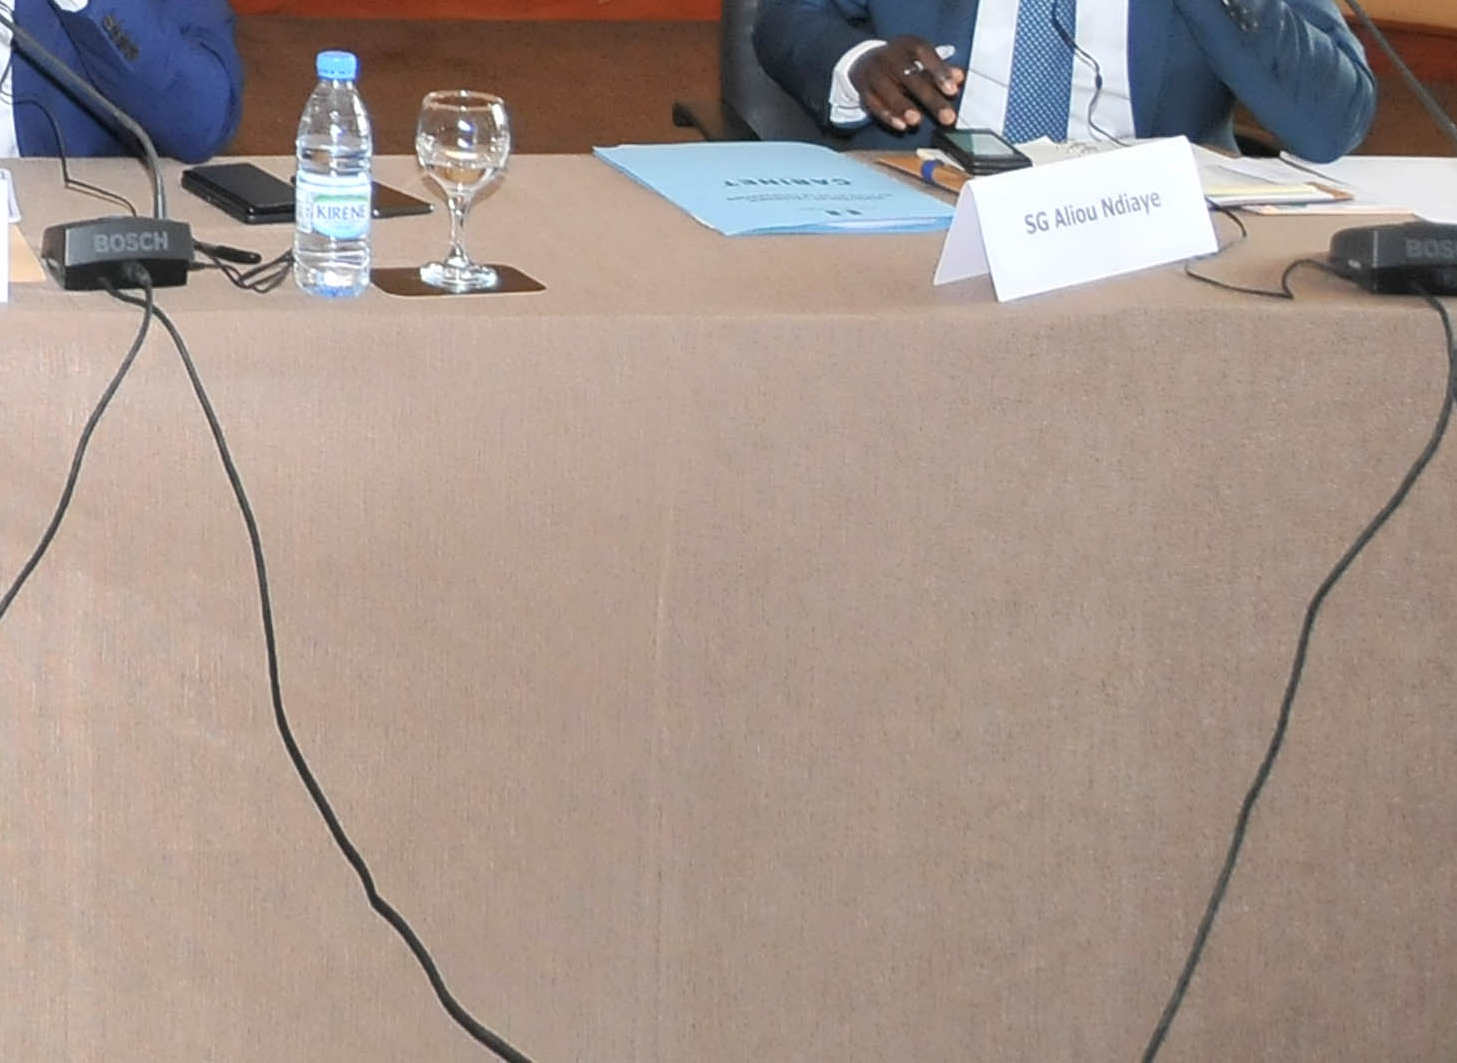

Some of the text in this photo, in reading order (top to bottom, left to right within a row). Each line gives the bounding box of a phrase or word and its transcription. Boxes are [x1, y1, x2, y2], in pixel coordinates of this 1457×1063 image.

[1024, 191, 1162, 235] SG Aliou Ndiaye
[94, 231, 169, 253] BOSCH
